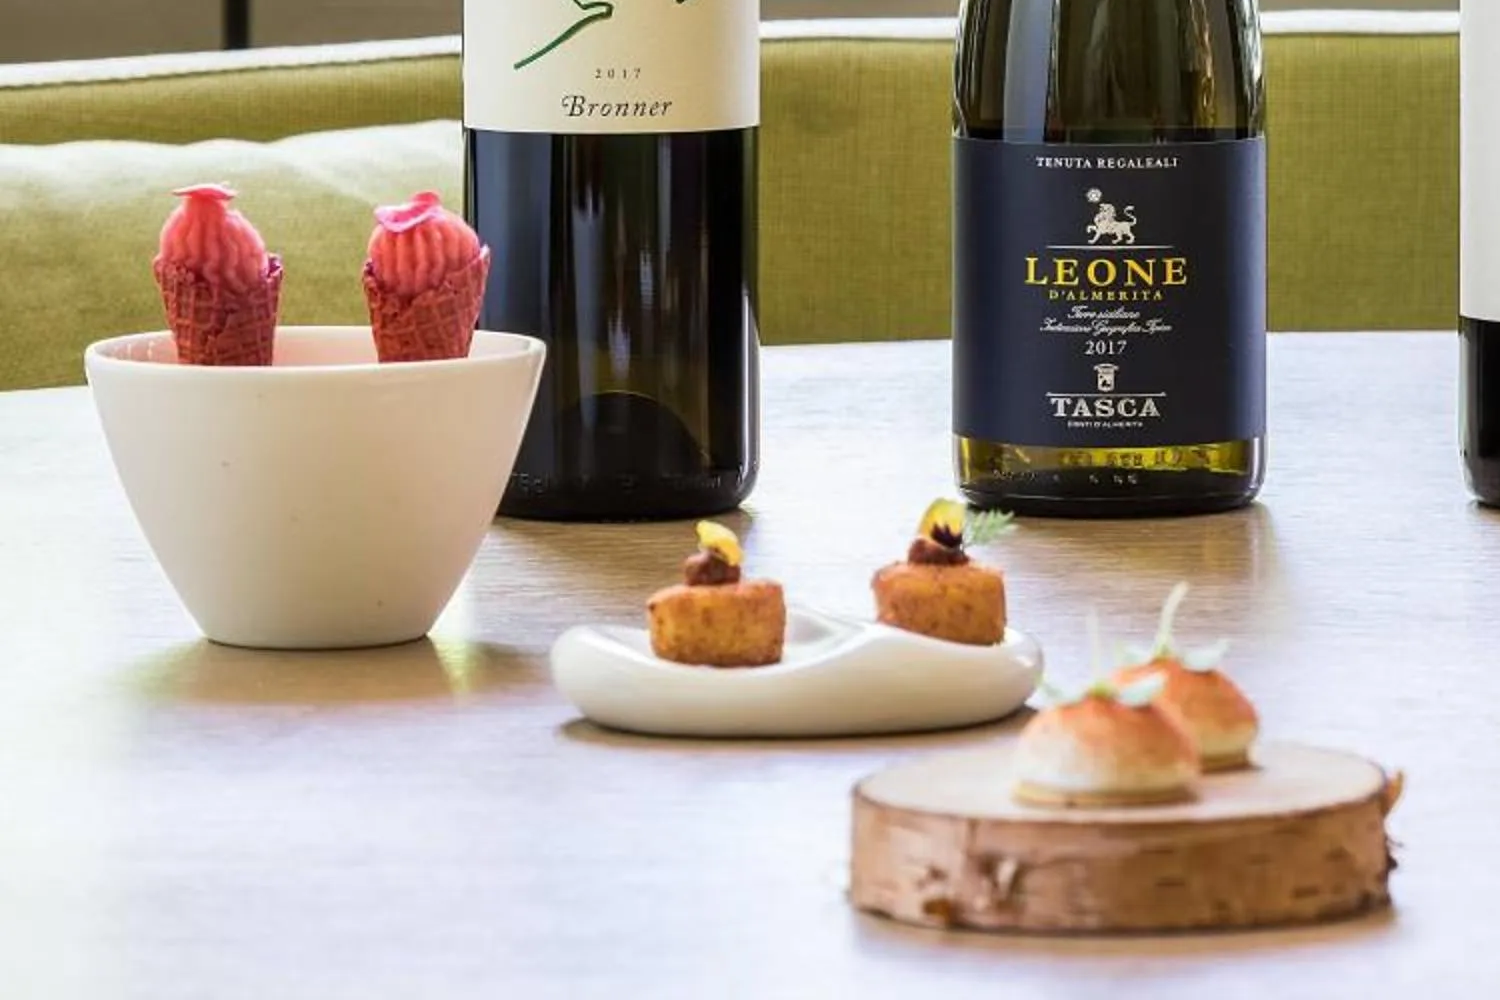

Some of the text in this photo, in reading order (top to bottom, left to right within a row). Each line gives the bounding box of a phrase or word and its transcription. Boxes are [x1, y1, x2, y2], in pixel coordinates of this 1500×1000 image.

[595, 68, 641, 79] 2017
[561, 95, 673, 118] Bronner
[1036, 157, 1178, 169] TENUTA REGALEALI
[1024, 257, 1188, 286] LEONE
[1049, 289, 1163, 301] D'ALMERITA
[1084, 339, 1128, 355] 2017
[1049, 397, 1161, 417] TASCA
